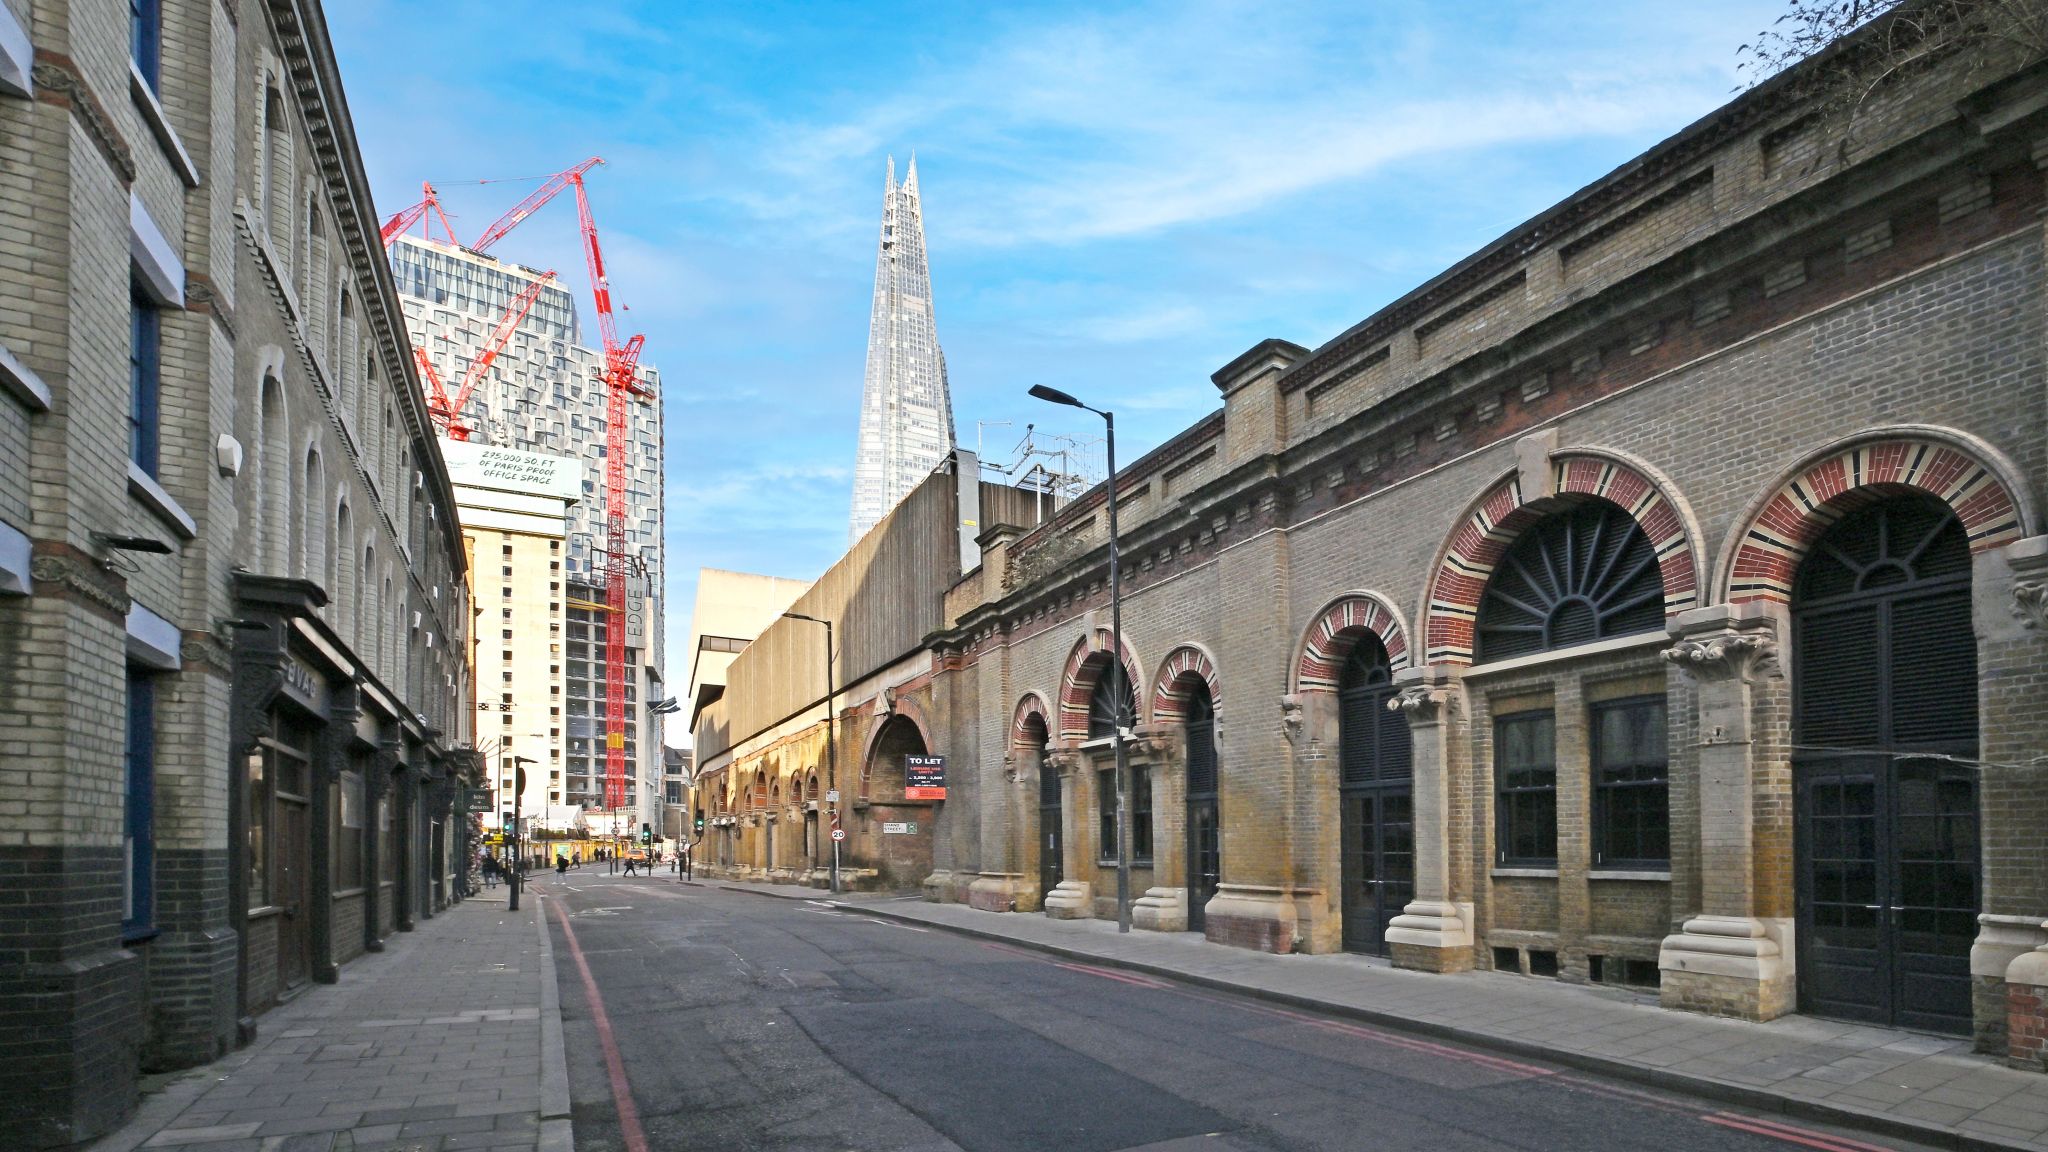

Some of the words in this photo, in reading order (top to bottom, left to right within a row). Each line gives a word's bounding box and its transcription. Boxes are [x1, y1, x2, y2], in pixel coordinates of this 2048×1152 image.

[479, 459, 492, 467] OF
[493, 461, 523, 472] PARIS
[525, 467, 557, 476] PROOF
[541, 459, 556, 468] FT
[483, 469, 517, 480] OFFICE
[520, 474, 552, 485] SPACE
[627, 589, 643, 637] EDGE
